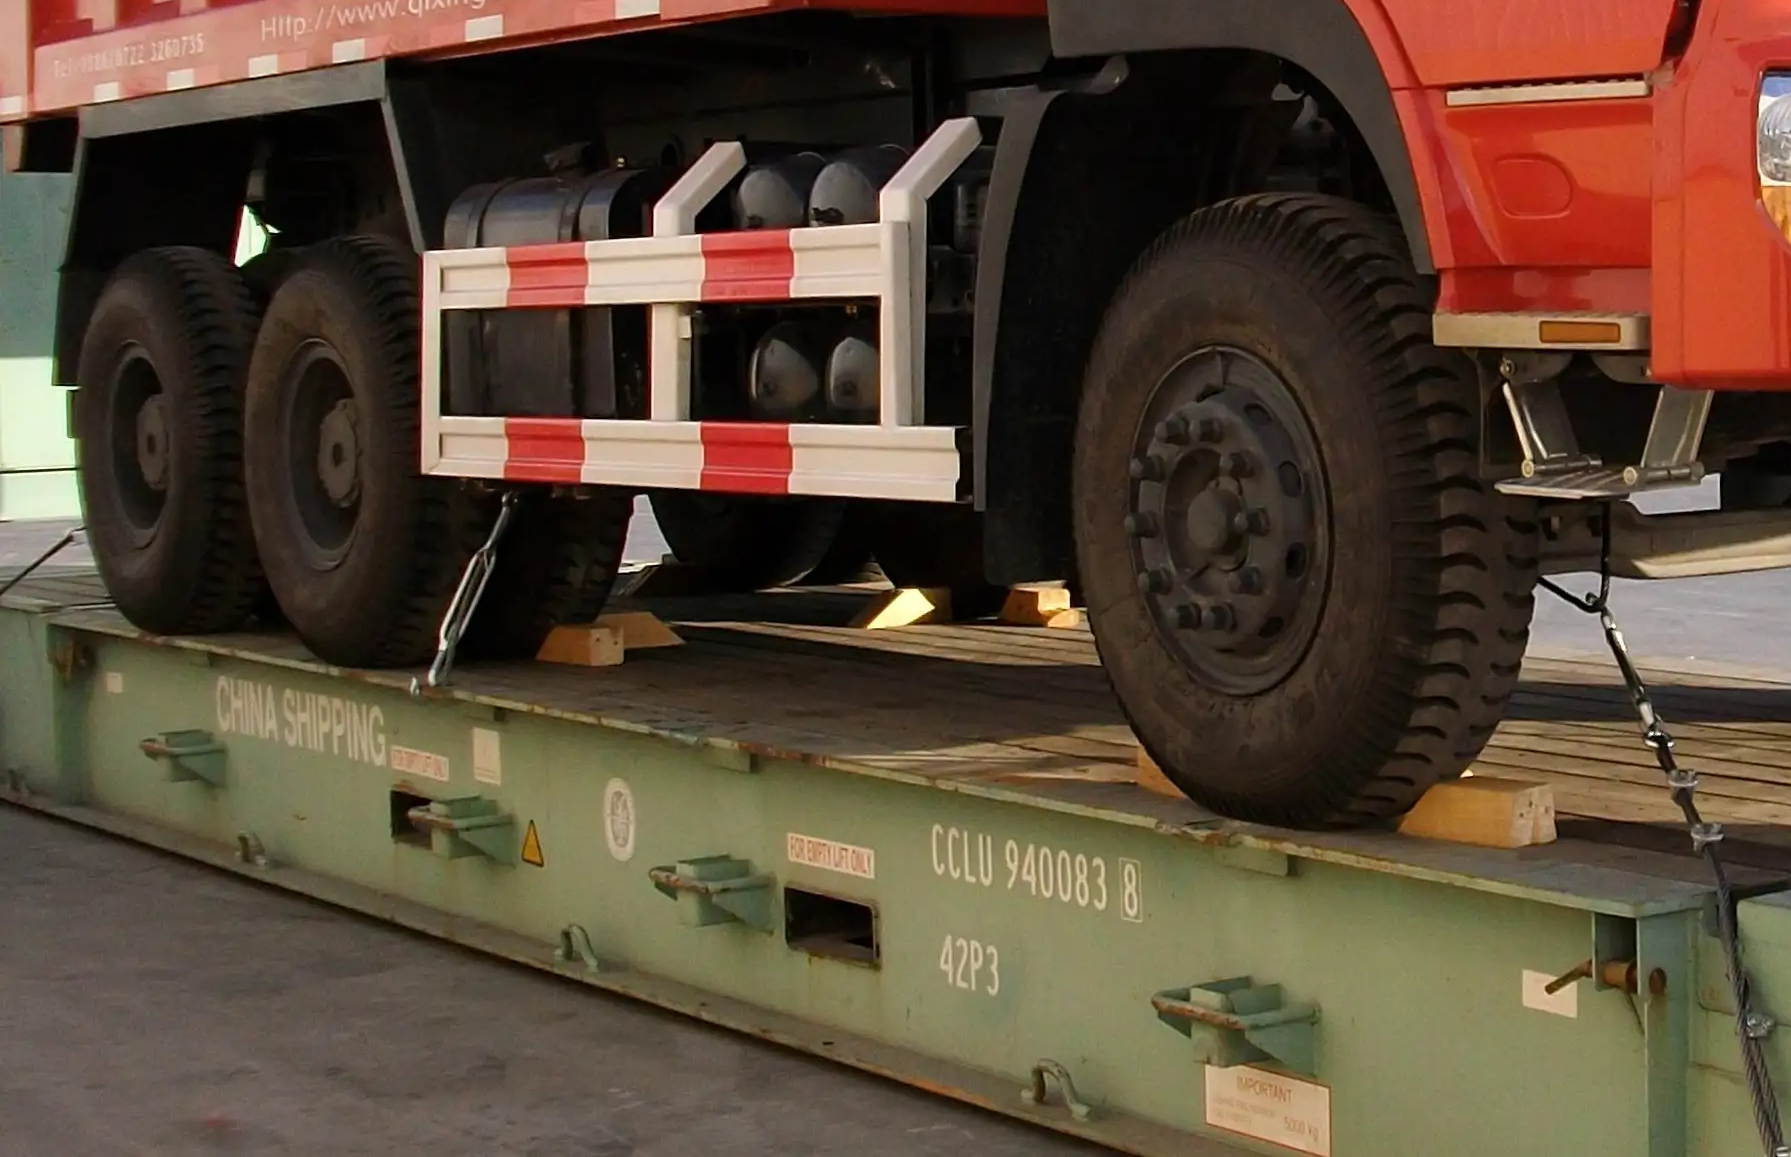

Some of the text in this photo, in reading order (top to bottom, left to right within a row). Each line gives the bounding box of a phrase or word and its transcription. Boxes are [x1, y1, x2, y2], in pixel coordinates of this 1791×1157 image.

[216, 675, 280, 742] CHINA
[282, 688, 387, 767] SHIPPING
[932, 823, 1139, 917] CCLU 940083 8
[939, 933, 999, 996] 42P3
[1236, 1074, 1293, 1103] IMPORTANT
